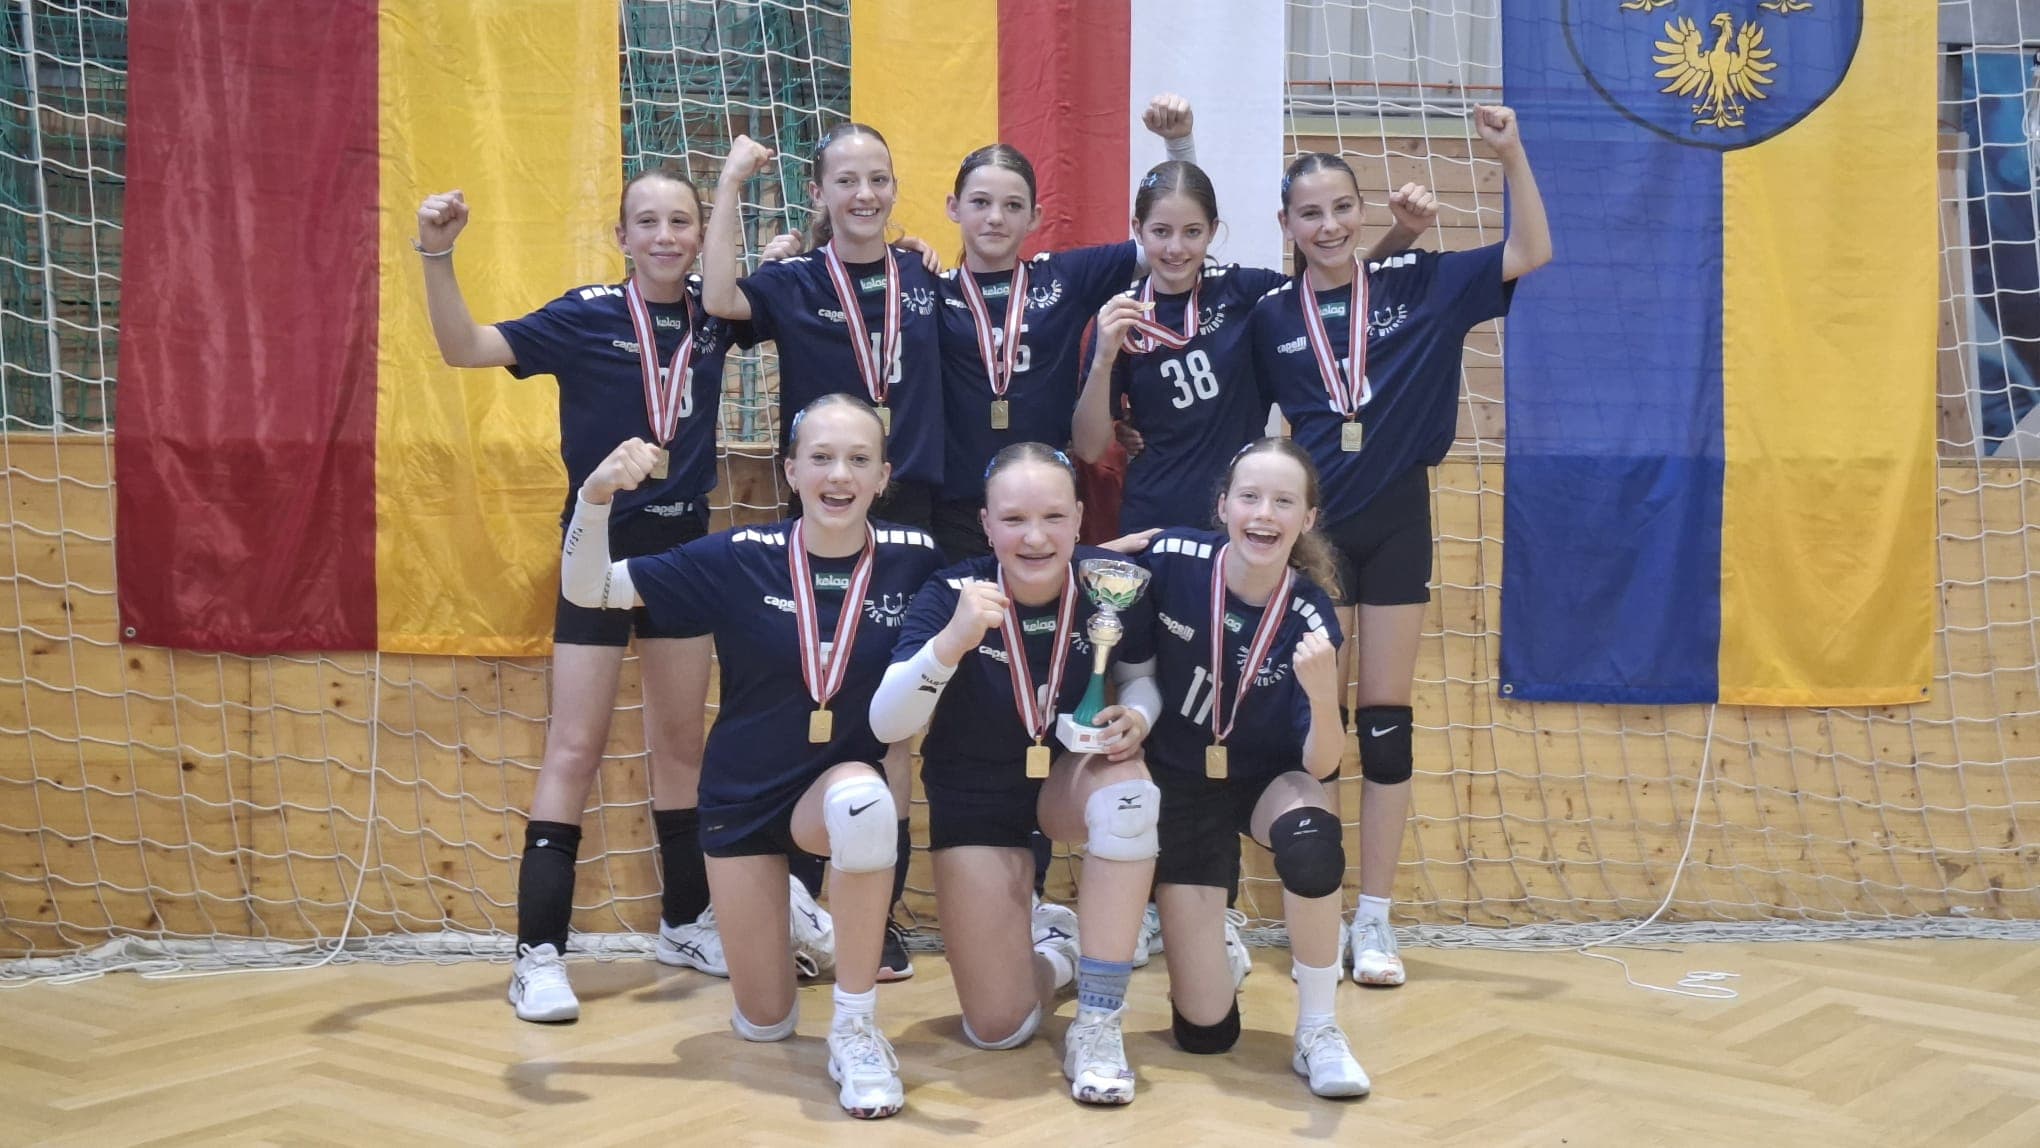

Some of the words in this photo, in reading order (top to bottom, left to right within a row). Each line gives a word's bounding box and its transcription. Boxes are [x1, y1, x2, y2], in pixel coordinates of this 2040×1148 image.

[818, 309, 847, 321] cape
[1320, 305, 1346, 316] elag
[656, 315, 681, 329] kelag
[1160, 349, 1219, 409] 38
[815, 573, 849, 589] kelag
[763, 596, 797, 611] cape
[1022, 619, 1057, 632] kelag
